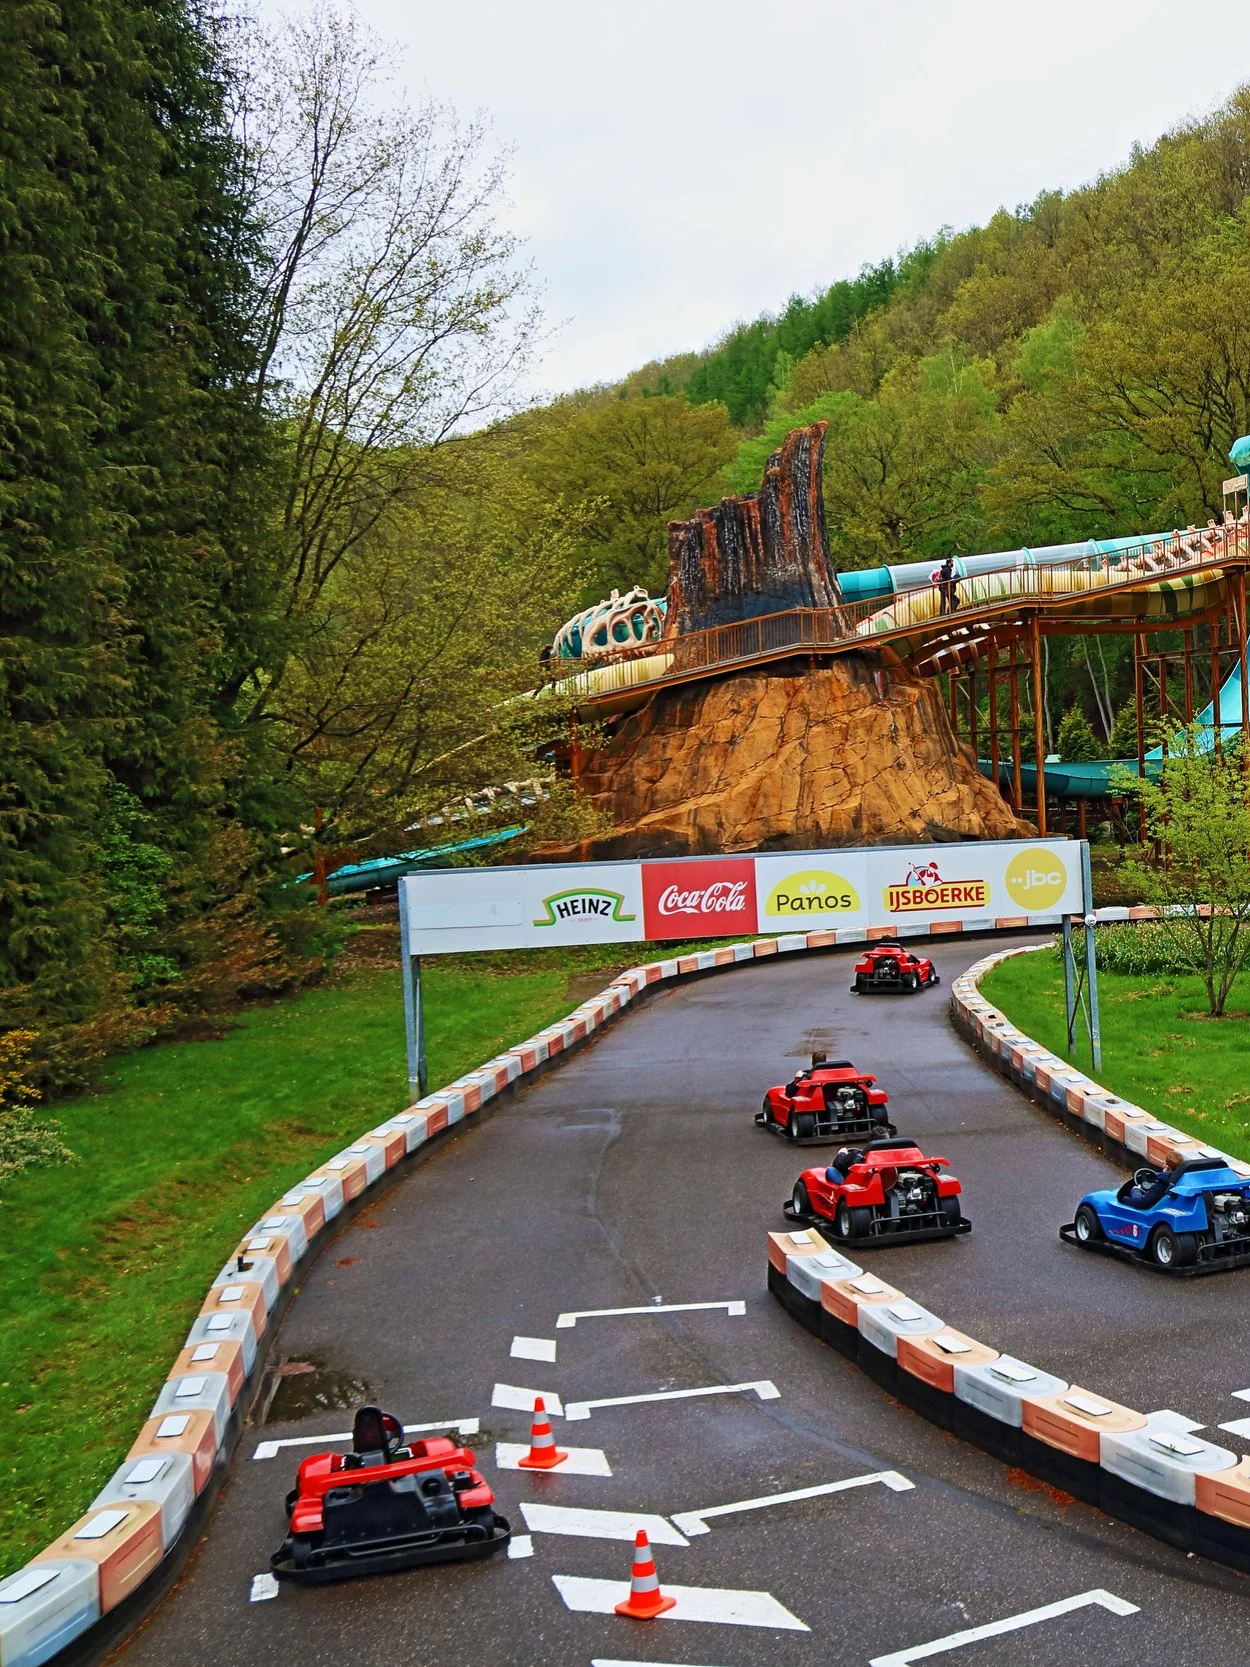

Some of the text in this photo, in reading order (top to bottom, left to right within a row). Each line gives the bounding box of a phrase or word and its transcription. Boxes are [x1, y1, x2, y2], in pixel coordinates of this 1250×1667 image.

[1023, 869, 1063, 890] jbc
[556, 898, 612, 919] HEINZ
[658, 881, 749, 915] Coca-Cola
[777, 893, 852, 912] Panos
[888, 886, 985, 912] IJSBOERKE
